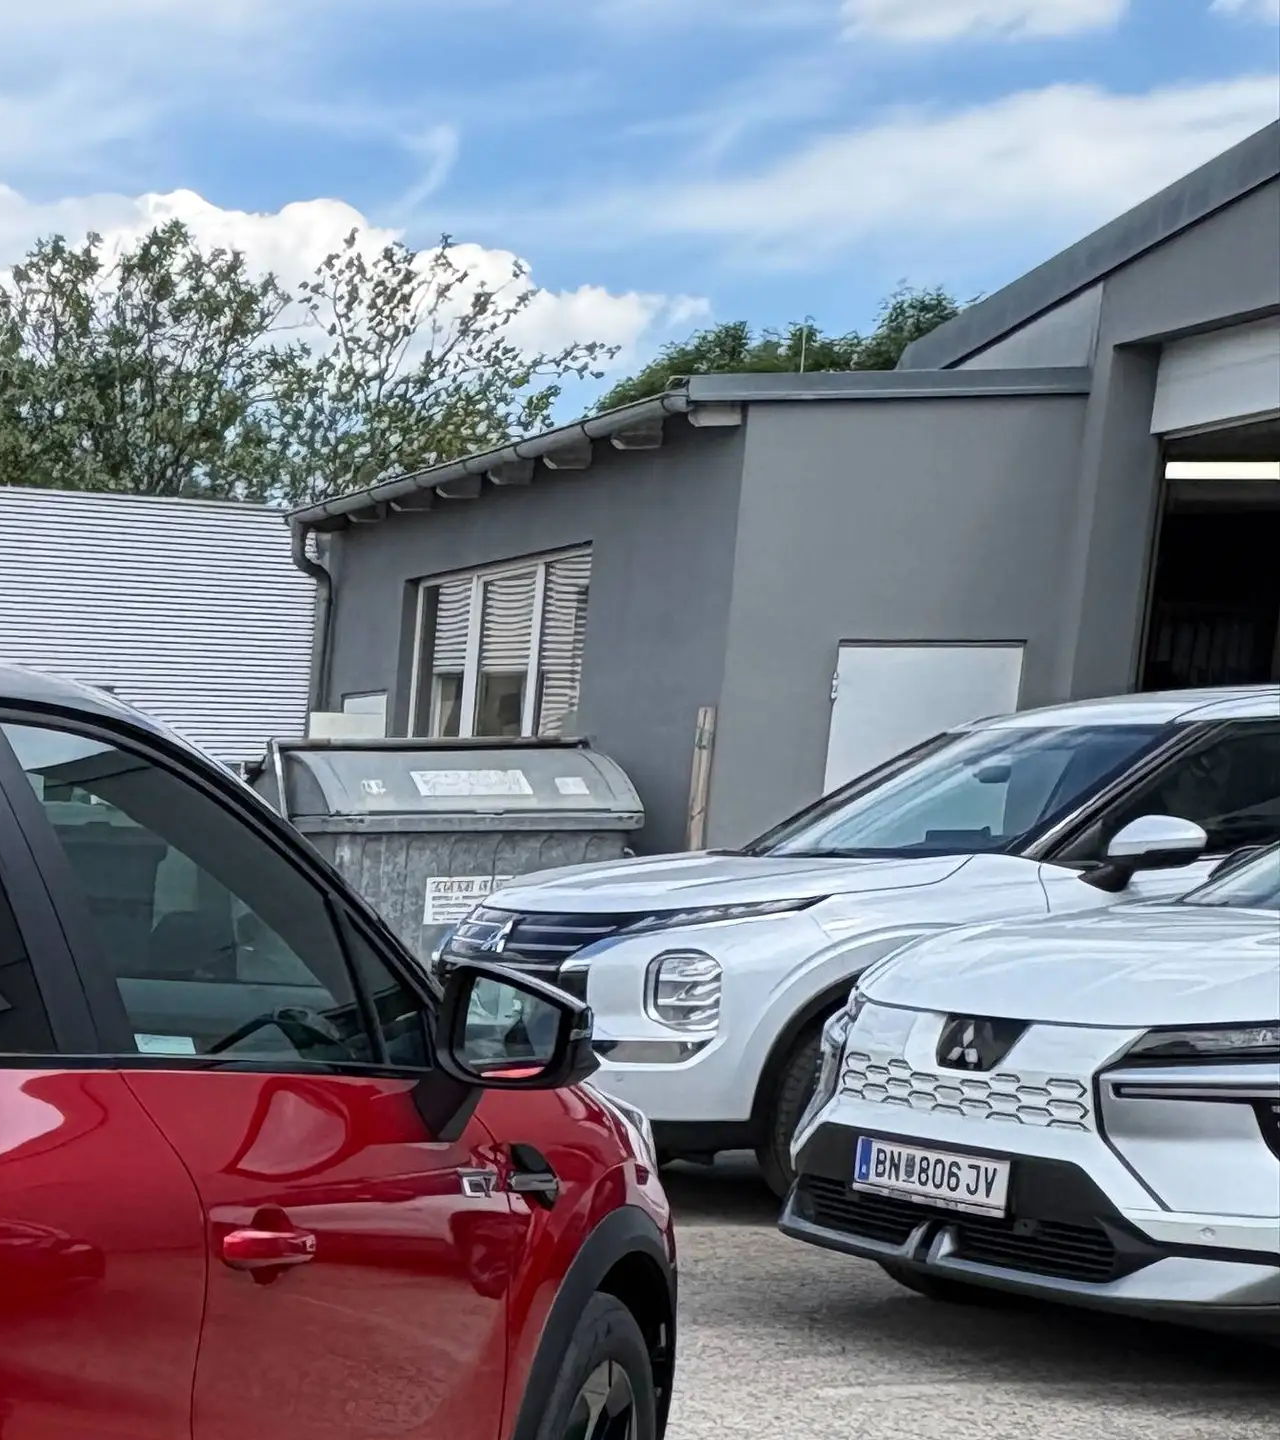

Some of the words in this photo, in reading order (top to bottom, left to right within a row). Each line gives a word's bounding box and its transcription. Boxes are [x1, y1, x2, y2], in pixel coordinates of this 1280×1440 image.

[874, 1148, 902, 1181] BN
[917, 1156, 962, 1192] 806
[966, 1164, 997, 1198] JV
